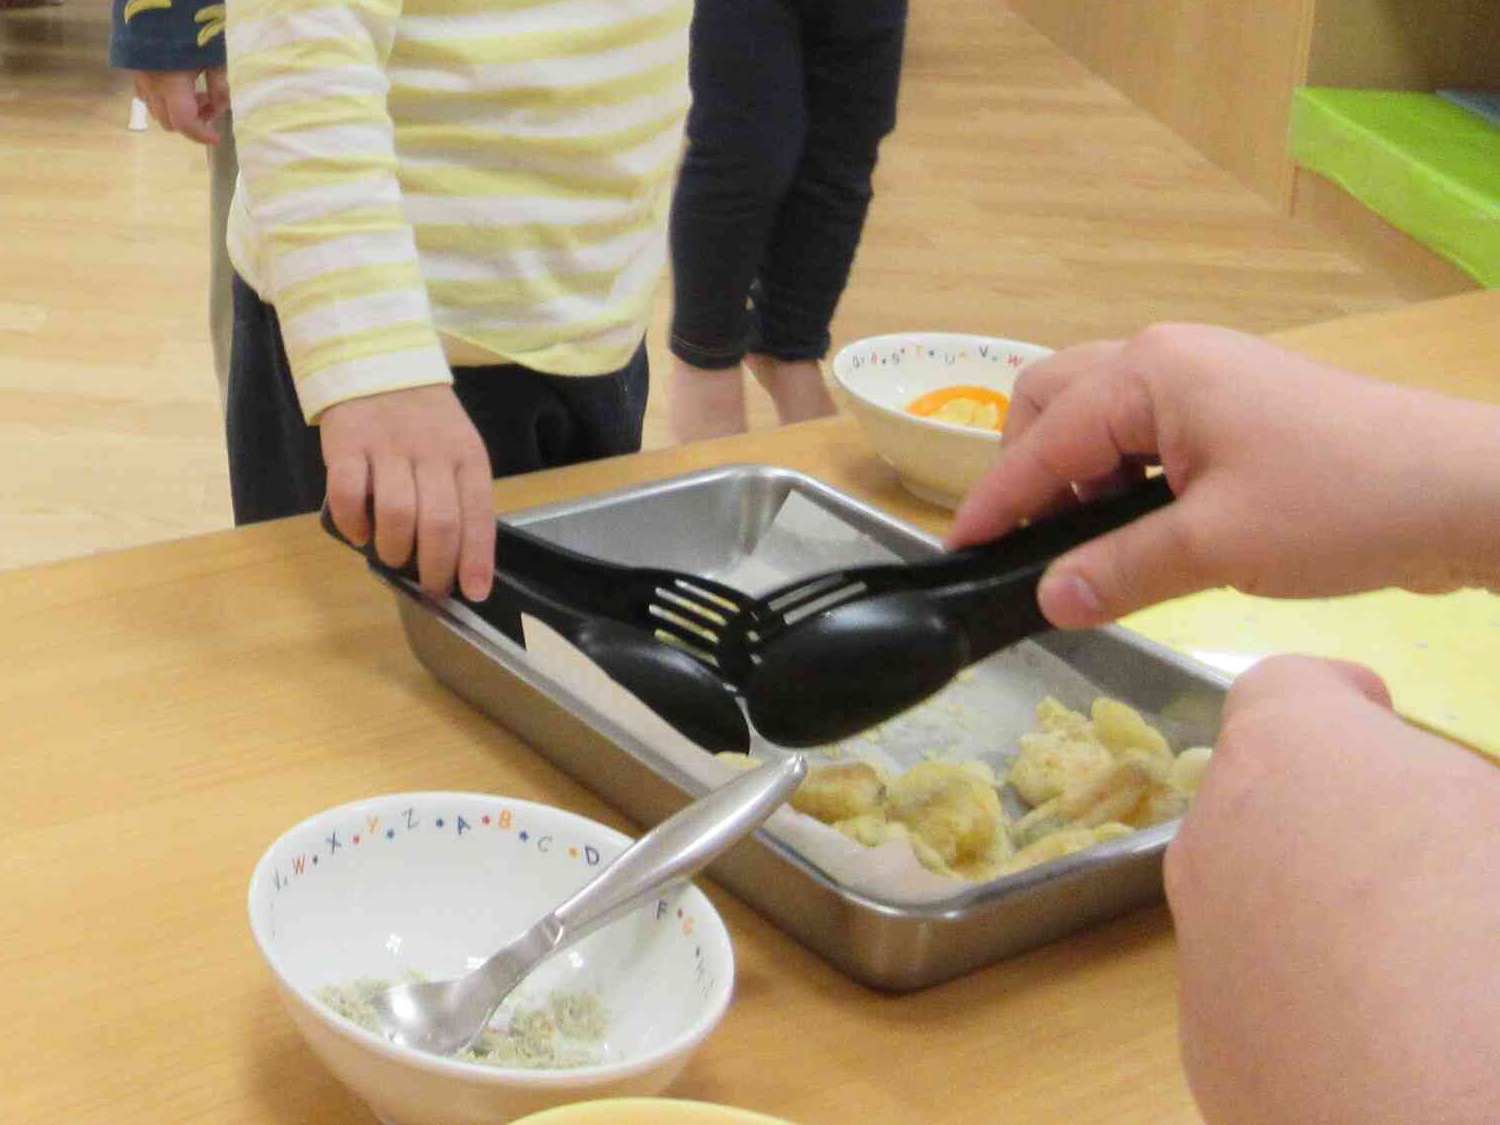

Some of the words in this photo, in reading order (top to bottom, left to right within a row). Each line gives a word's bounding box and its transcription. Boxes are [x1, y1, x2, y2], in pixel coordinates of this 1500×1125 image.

[979, 346, 989, 358] V
[292, 854, 307, 876] W
[325, 830, 343, 855] X
[366, 814, 379, 835] Y
[402, 807, 420, 829] Z
[457, 815, 472, 836] A
[499, 810, 512, 828] B
[538, 835, 553, 853] C
[584, 845, 601, 867] D
